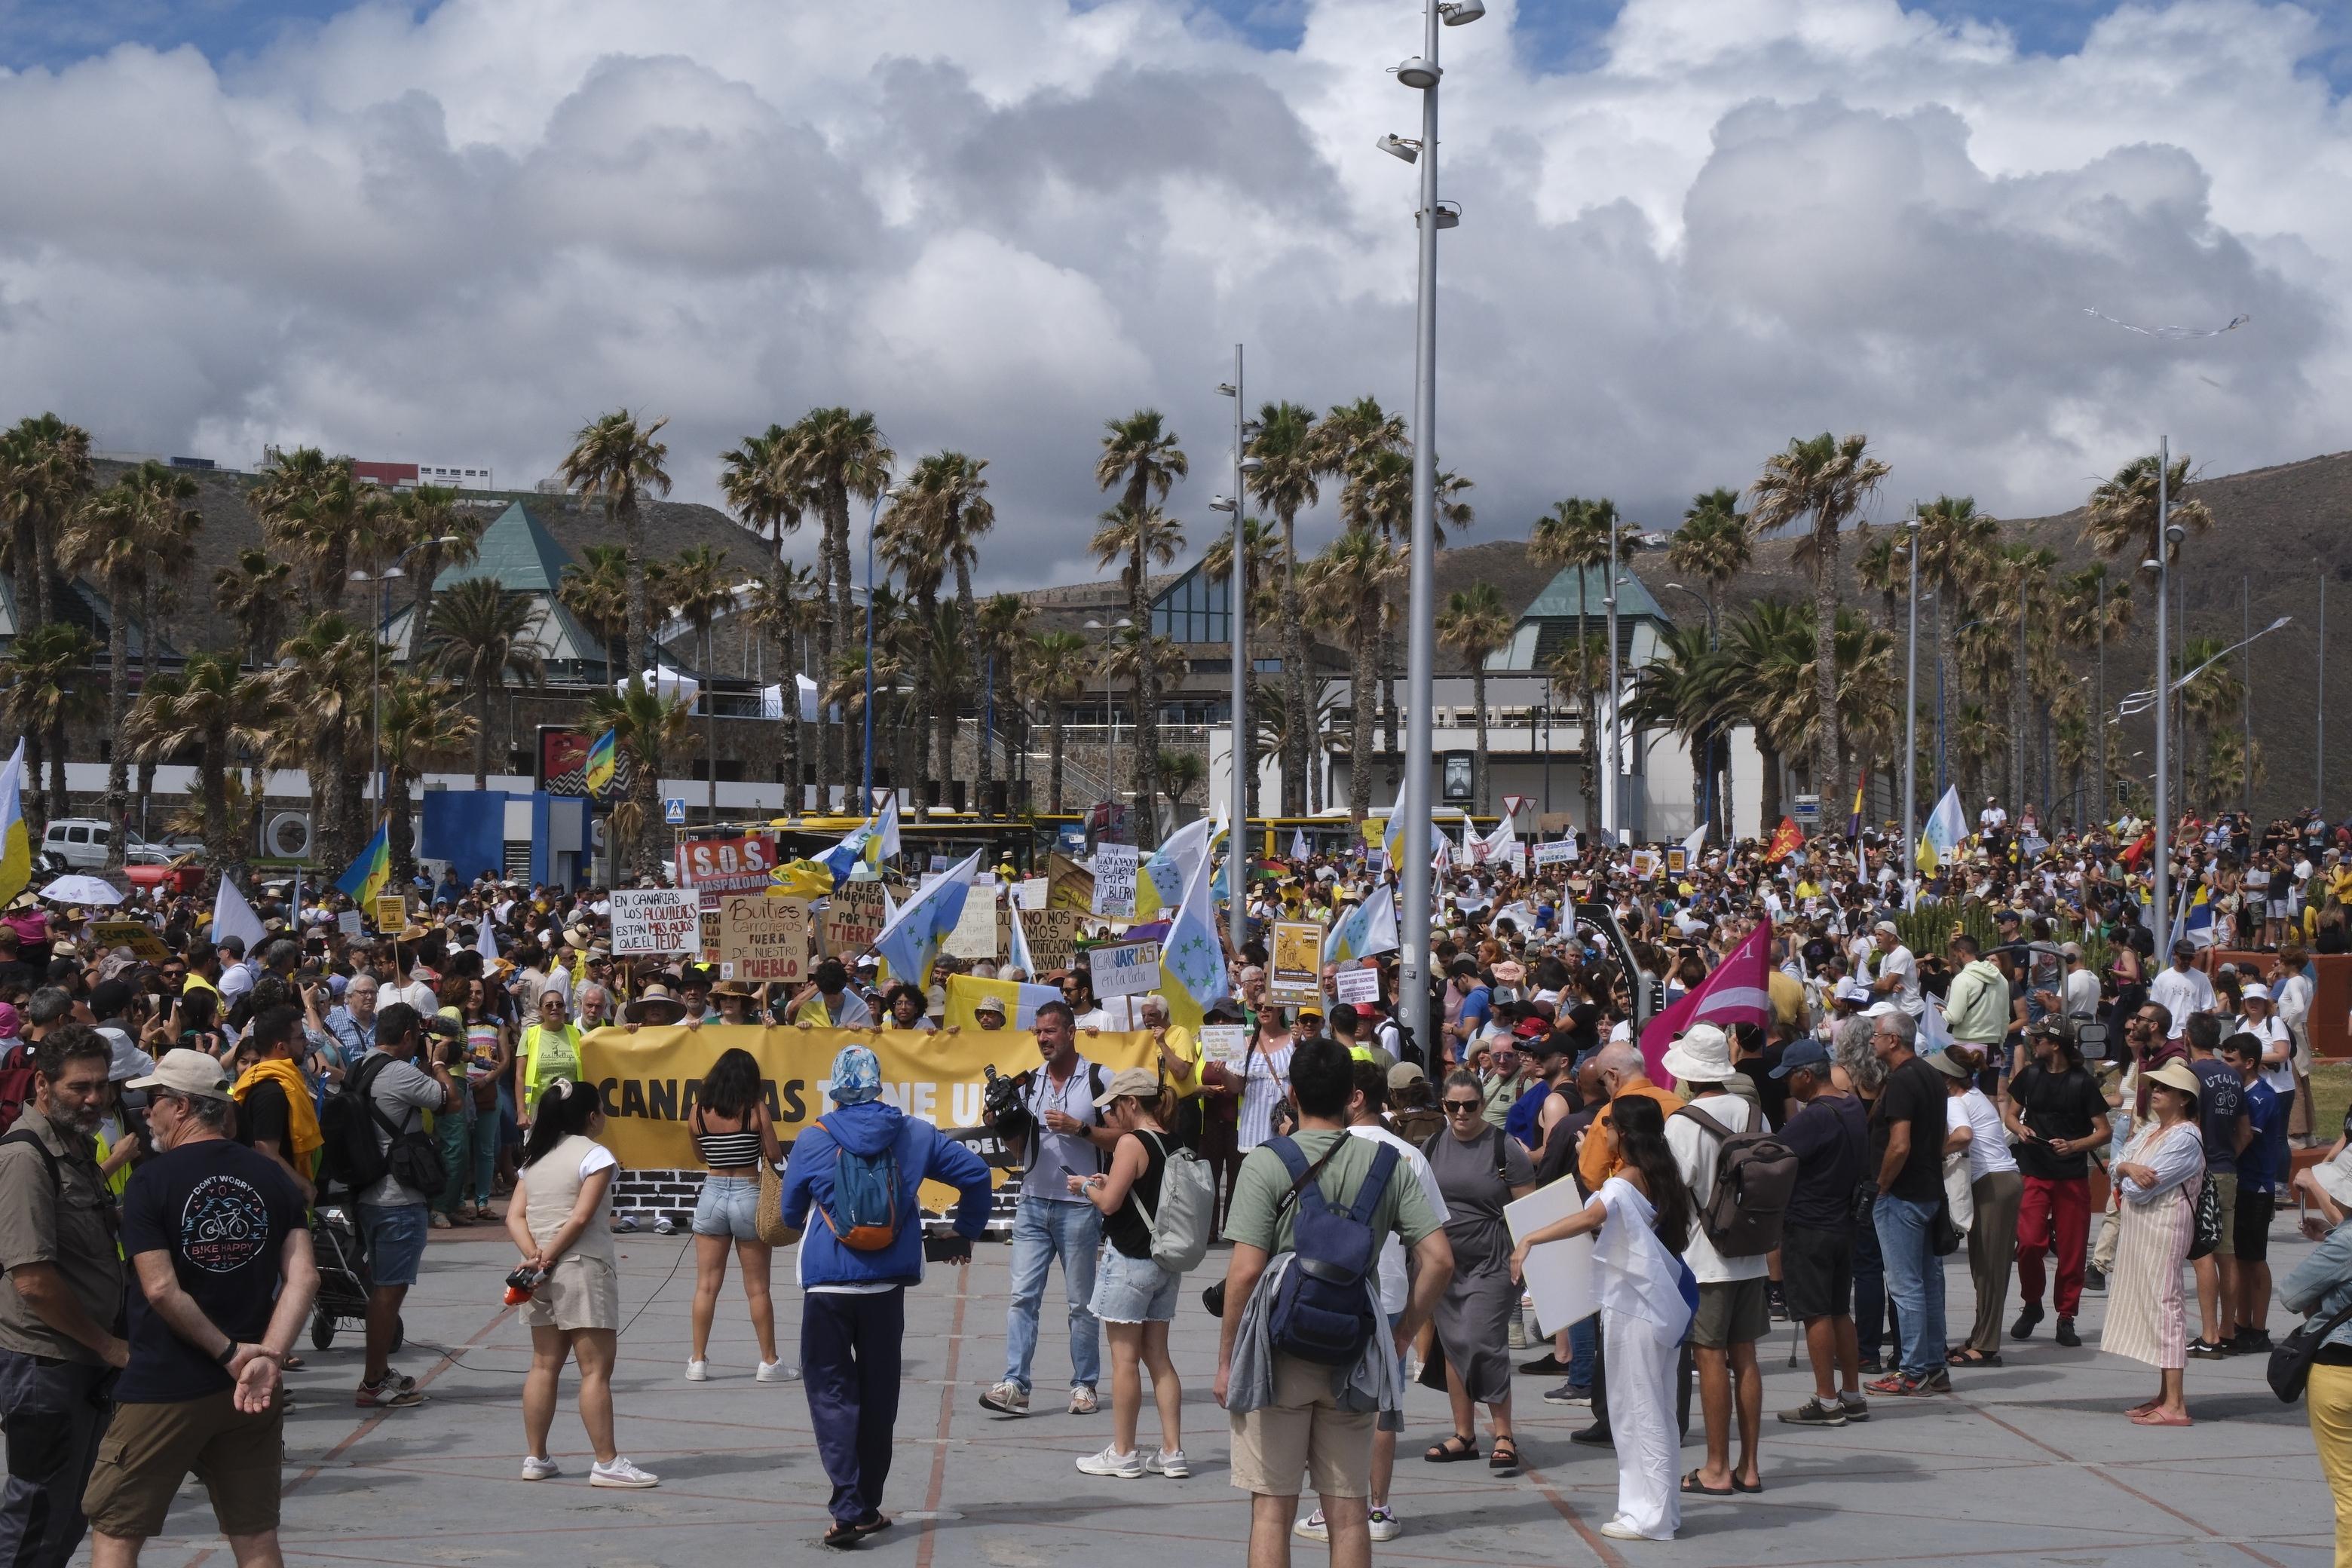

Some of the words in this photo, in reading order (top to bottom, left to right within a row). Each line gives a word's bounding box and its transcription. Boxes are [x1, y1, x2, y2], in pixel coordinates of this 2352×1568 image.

[694, 841, 771, 877] S.O.S.
[1097, 865, 1110, 874] se
[1103, 874, 1116, 884] en
[835, 890, 885, 905] HORMIGO
[1095, 884, 1136, 901] TABLERO
[614, 896, 627, 908] EN
[632, 893, 680, 905] CANARIAS
[624, 907, 642, 919] LOS
[728, 898, 801, 920] Buitres
[851, 902, 859, 914] Y
[865, 905, 885, 917] LUC
[839, 911, 860, 926] POR
[1023, 911, 1042, 926] NO
[1047, 910, 1070, 925] NOS
[616, 922, 646, 936] ESTÁN
[669, 920, 694, 933] ALTOS
[829, 923, 884, 944] TIERR
[619, 937, 641, 949] QUE
[642, 936, 653, 948] EL
[652, 933, 686, 950] TEIDE
[749, 933, 786, 945] FUERA
[732, 947, 749, 960] DE
[755, 946, 798, 958] NUESTRO
[996, 942, 1009, 954] LA
[1094, 945, 1156, 971] CANARIAS
[743, 958, 798, 978] PUEBLO
[599, 1077, 806, 1123] CANAAS
[192, 1175, 217, 1196] DON'T
[219, 1175, 253, 1192] WORRY
[221, 1242, 253, 1252] HAPPY
